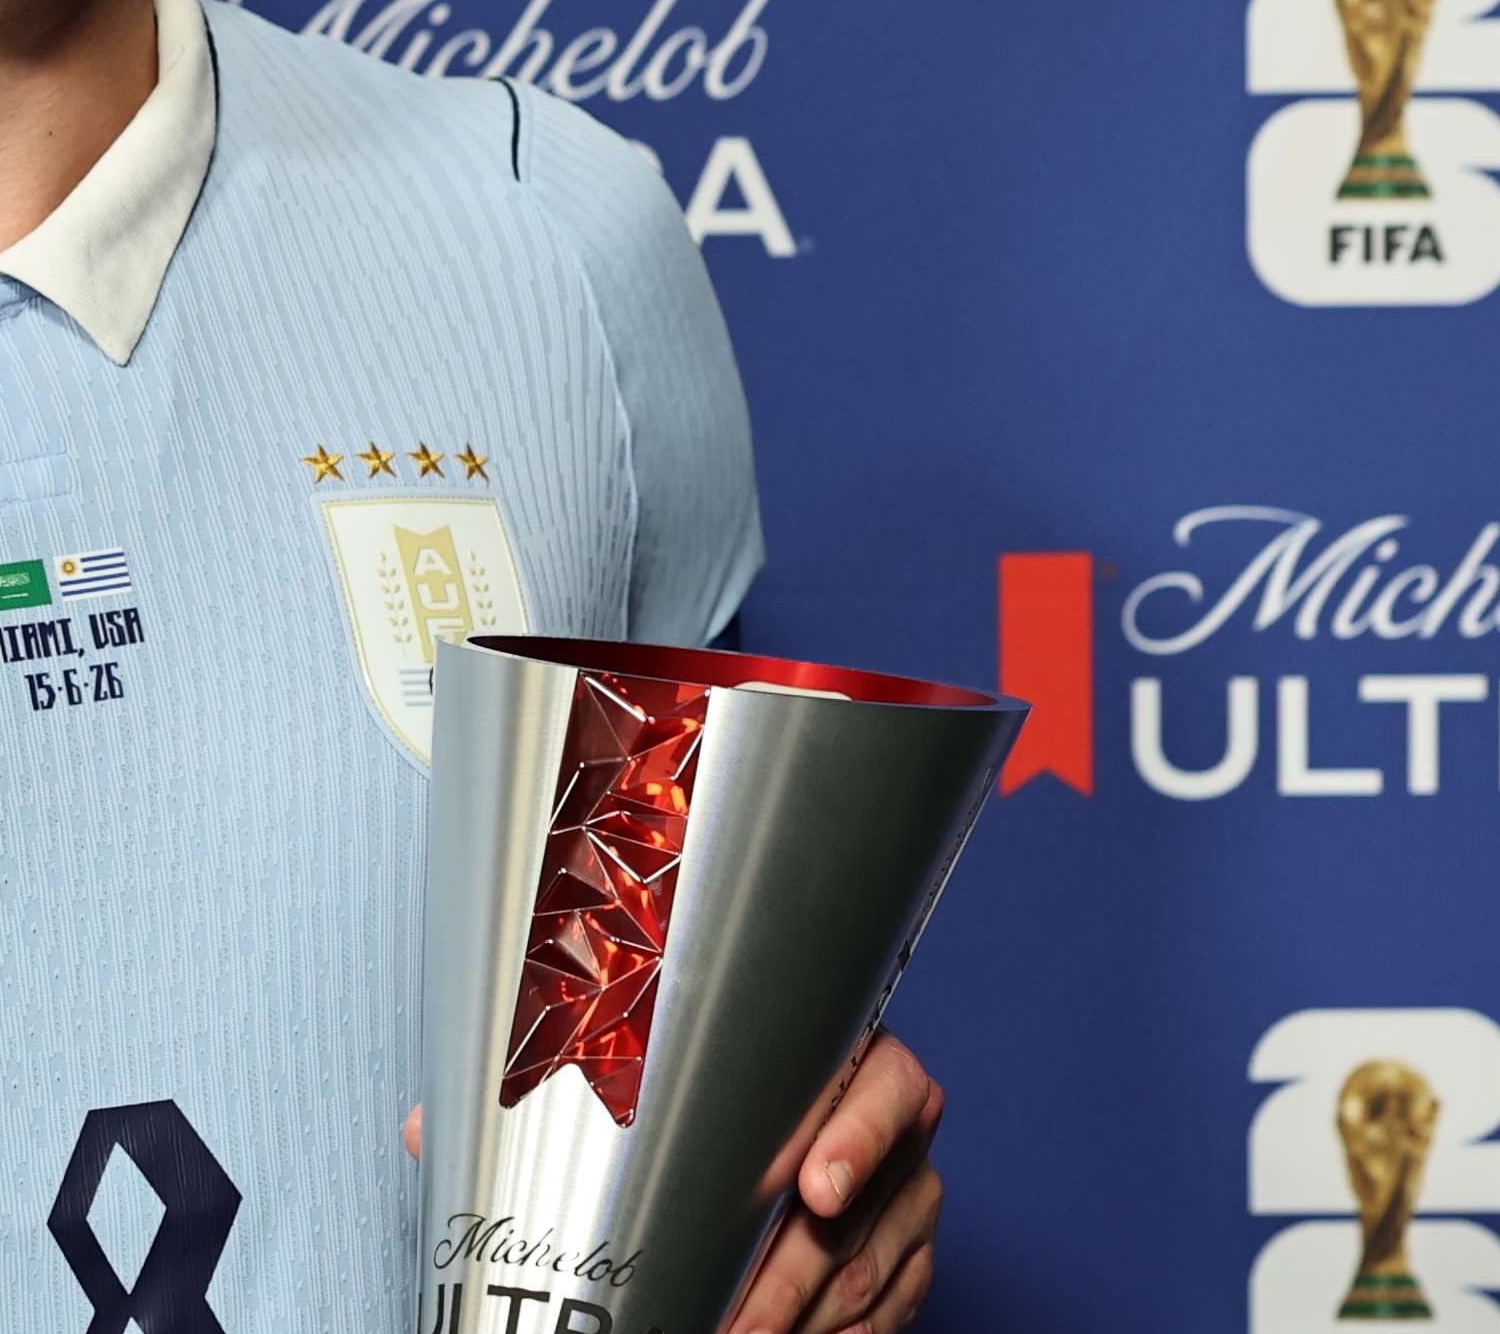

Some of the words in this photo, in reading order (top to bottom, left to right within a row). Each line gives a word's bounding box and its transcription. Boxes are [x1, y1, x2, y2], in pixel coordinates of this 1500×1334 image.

[1330, 226, 1442, 262] FIFA
[89, 607, 145, 650] USA
[434, 1213, 645, 1287] Michelob
